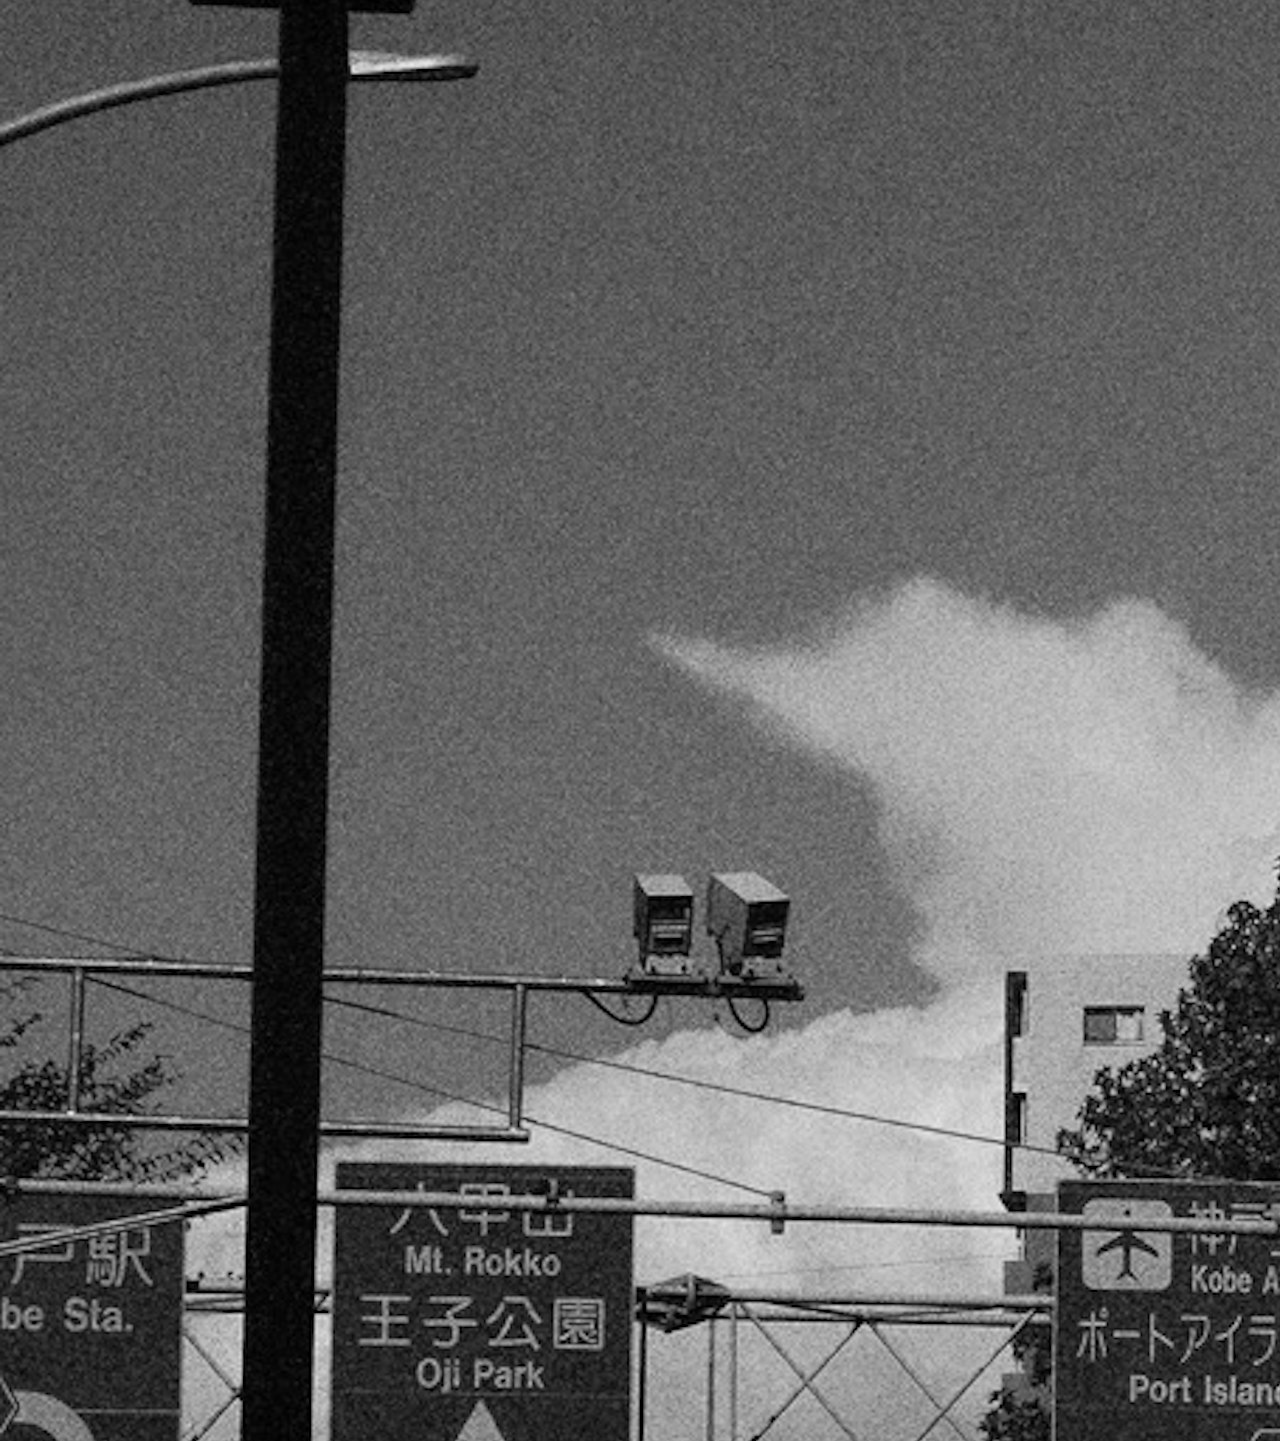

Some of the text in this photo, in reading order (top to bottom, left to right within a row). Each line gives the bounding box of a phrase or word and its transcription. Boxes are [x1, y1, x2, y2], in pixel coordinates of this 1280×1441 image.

[389, 1180, 574, 1237] 六甲山
[404, 1244, 562, 1277] Mt. Rokko
[1191, 1264, 1252, 1294] Kobe
[1, 1295, 134, 1333] be Sta.
[358, 1294, 606, 1352] 王子公園
[415, 1357, 546, 1394] Oji Park
[1128, 1375, 1192, 1405] Port
